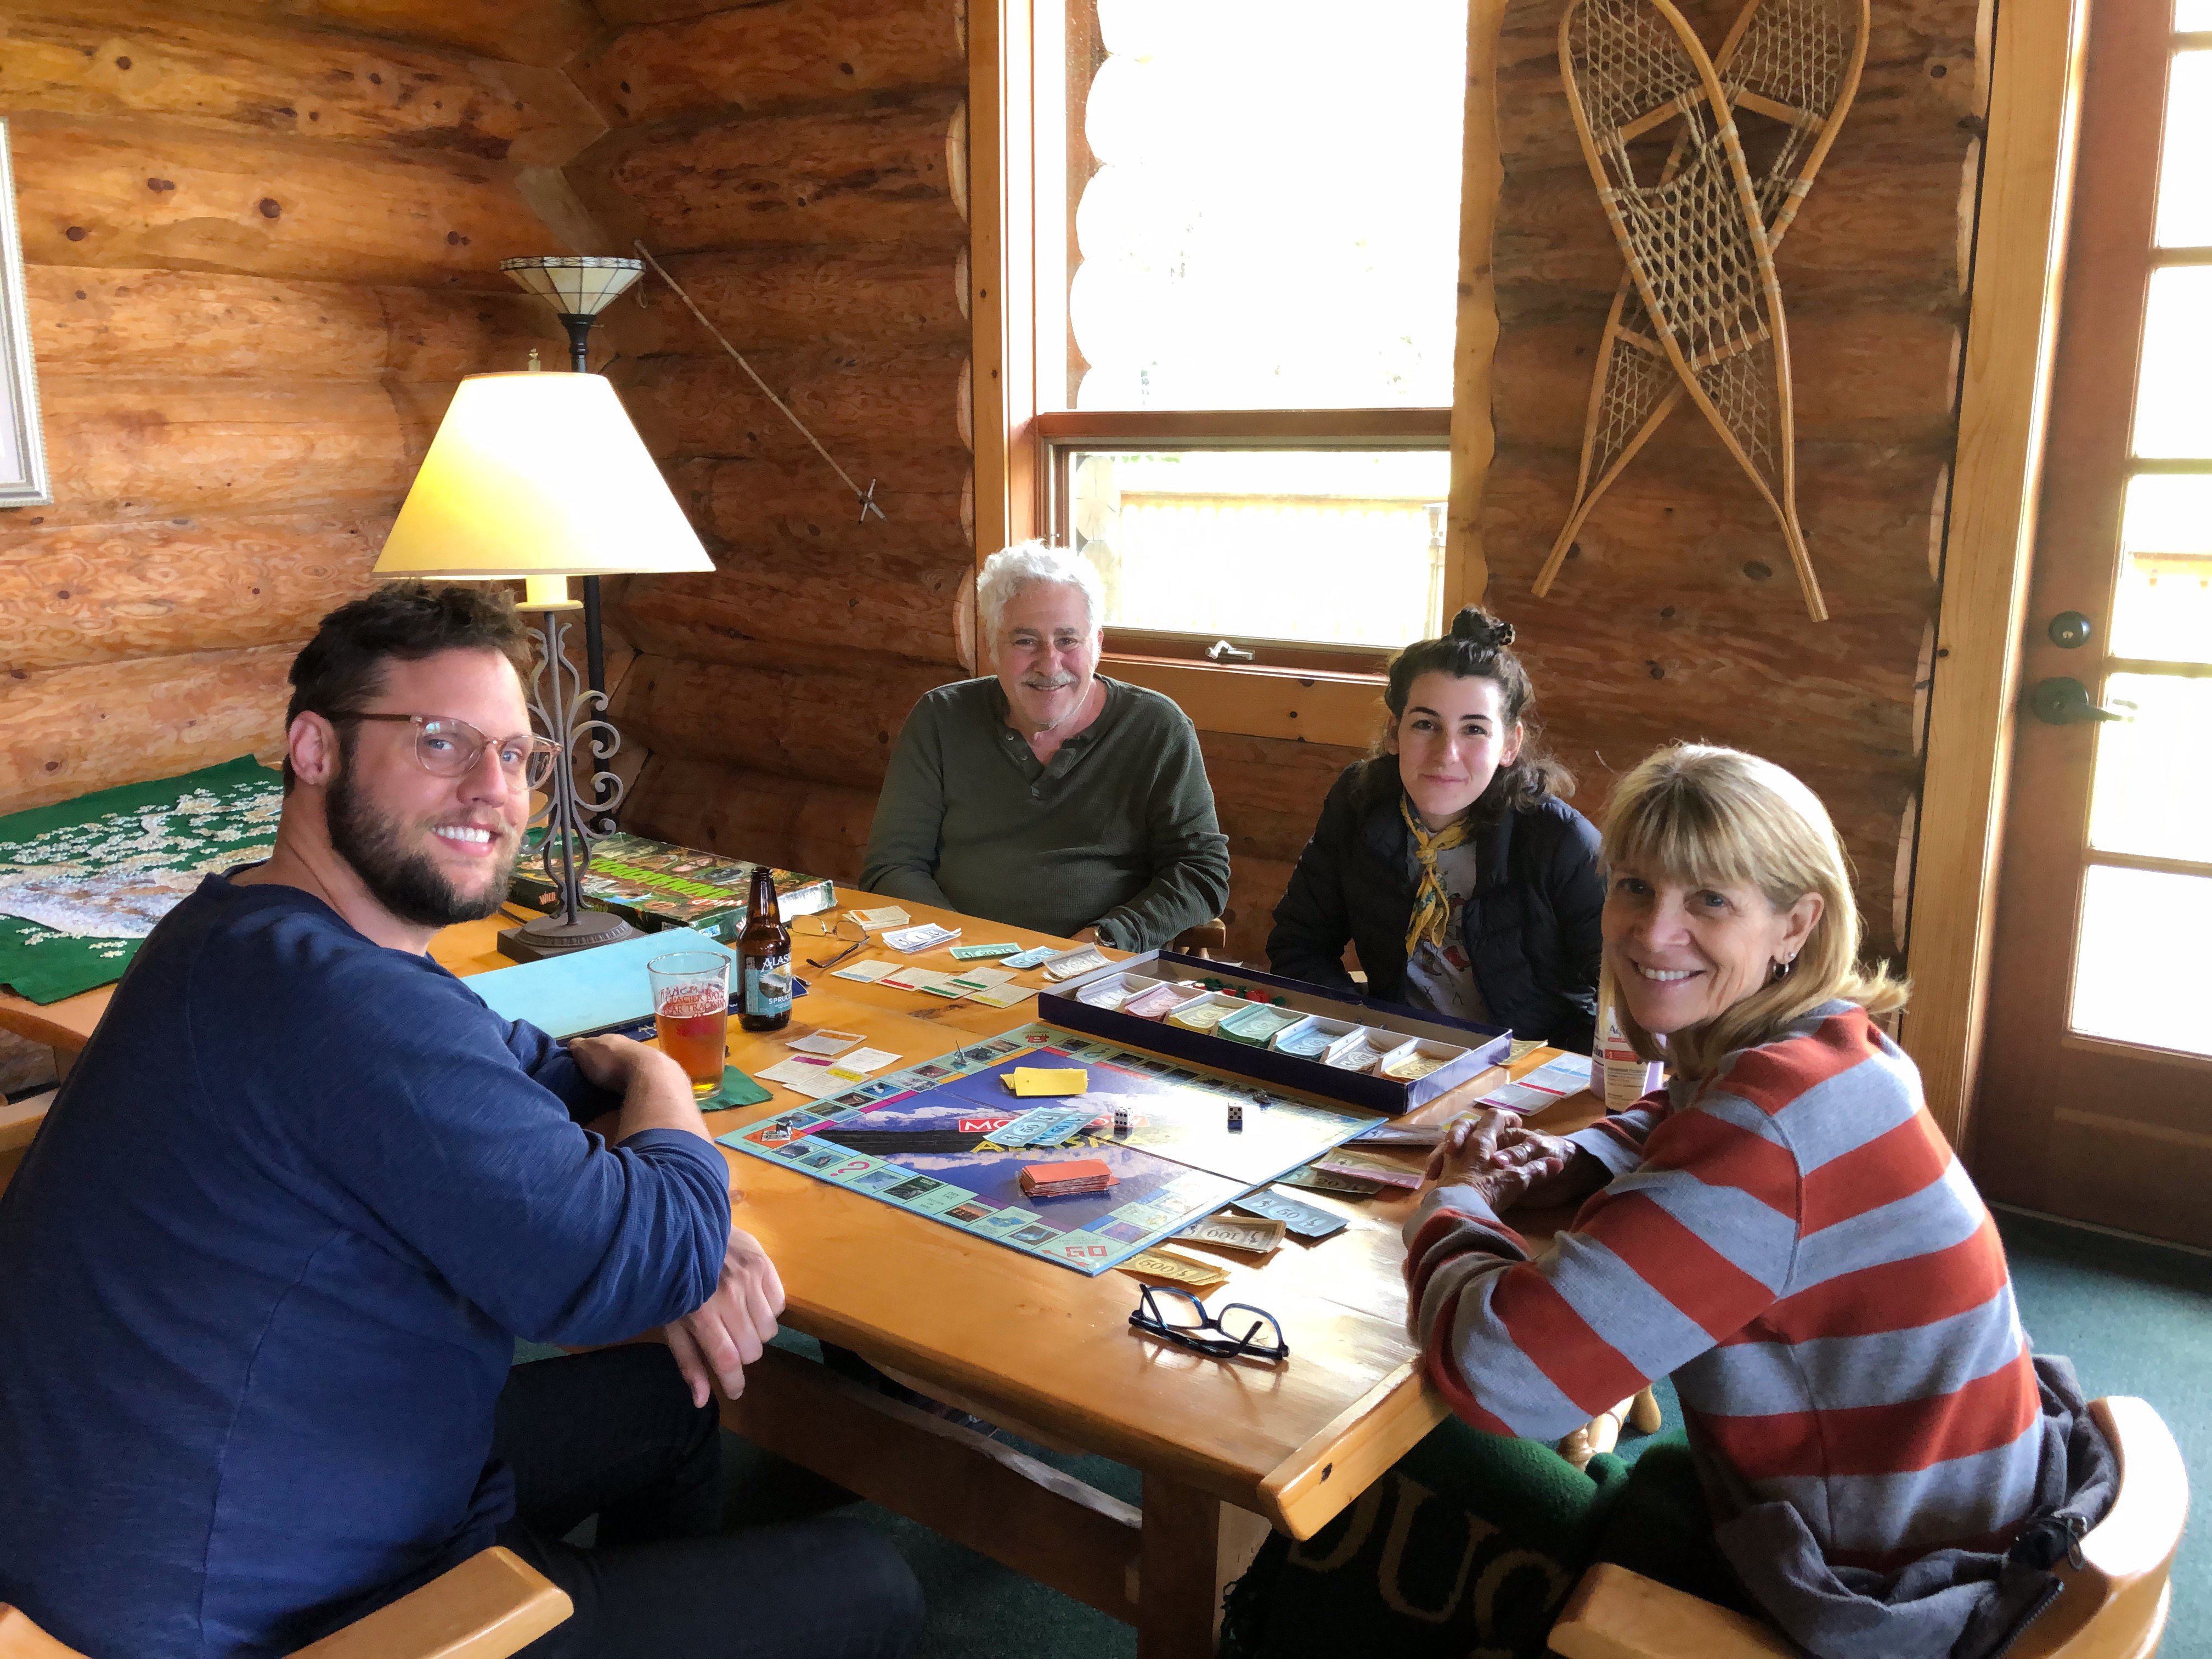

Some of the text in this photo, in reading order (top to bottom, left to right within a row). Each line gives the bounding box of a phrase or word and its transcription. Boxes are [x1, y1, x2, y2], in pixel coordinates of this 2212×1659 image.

[539, 891, 556, 905] WILD
[691, 898, 743, 906] WILD
[665, 994, 703, 1005] GLACIER
[686, 1001, 716, 1012] TRACK
[1353, 1053, 1375, 1064] 100
[1019, 1124, 1041, 1133] 50
[1049, 1124, 1071, 1133] 50
[1275, 1208, 1300, 1219] 50
[1206, 1230, 1238, 1240] 100
[1065, 1245, 1108, 1257] GO
[1142, 1257, 1175, 1273] 500
